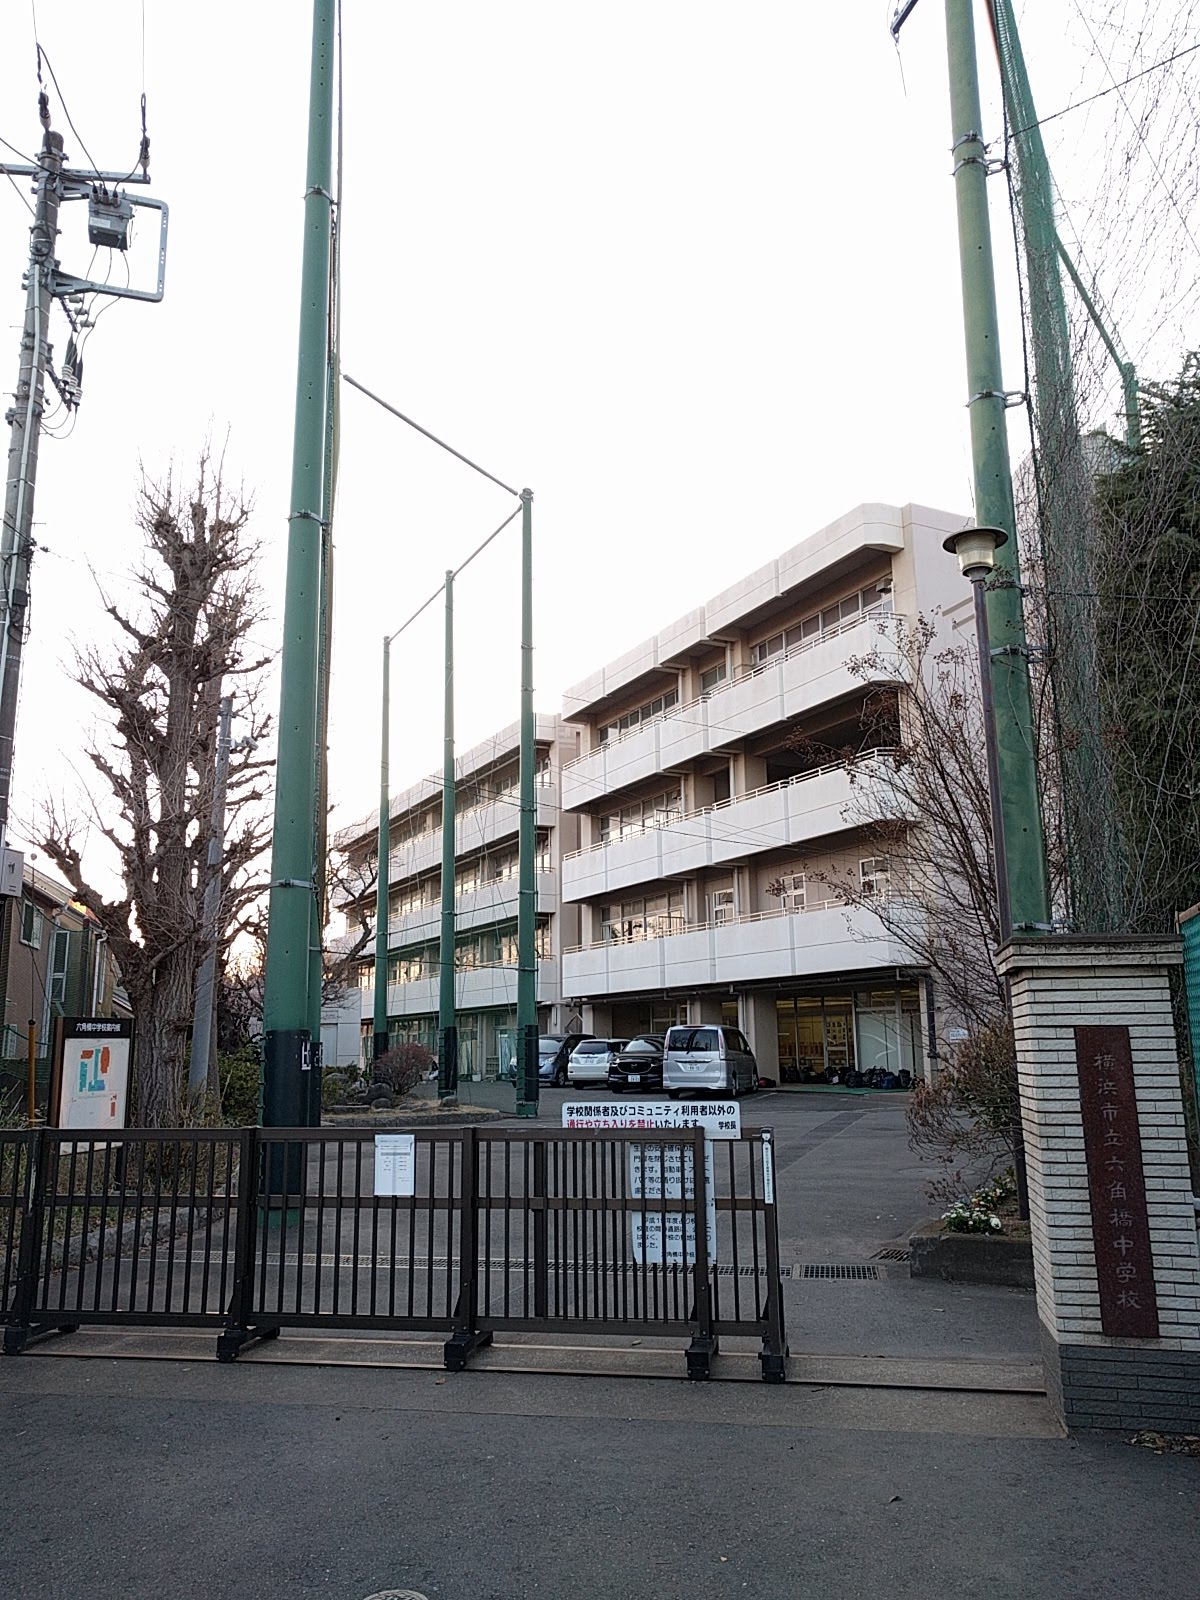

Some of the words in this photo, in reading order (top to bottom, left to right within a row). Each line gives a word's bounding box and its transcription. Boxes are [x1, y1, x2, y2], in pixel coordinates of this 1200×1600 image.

[566, 1105, 736, 1117] 学校関係者及びコミュニティ利用者以外の
[718, 1121, 737, 1130] 学校長
[1093, 1053, 1141, 1309] 横浜市立六角橋中学校
